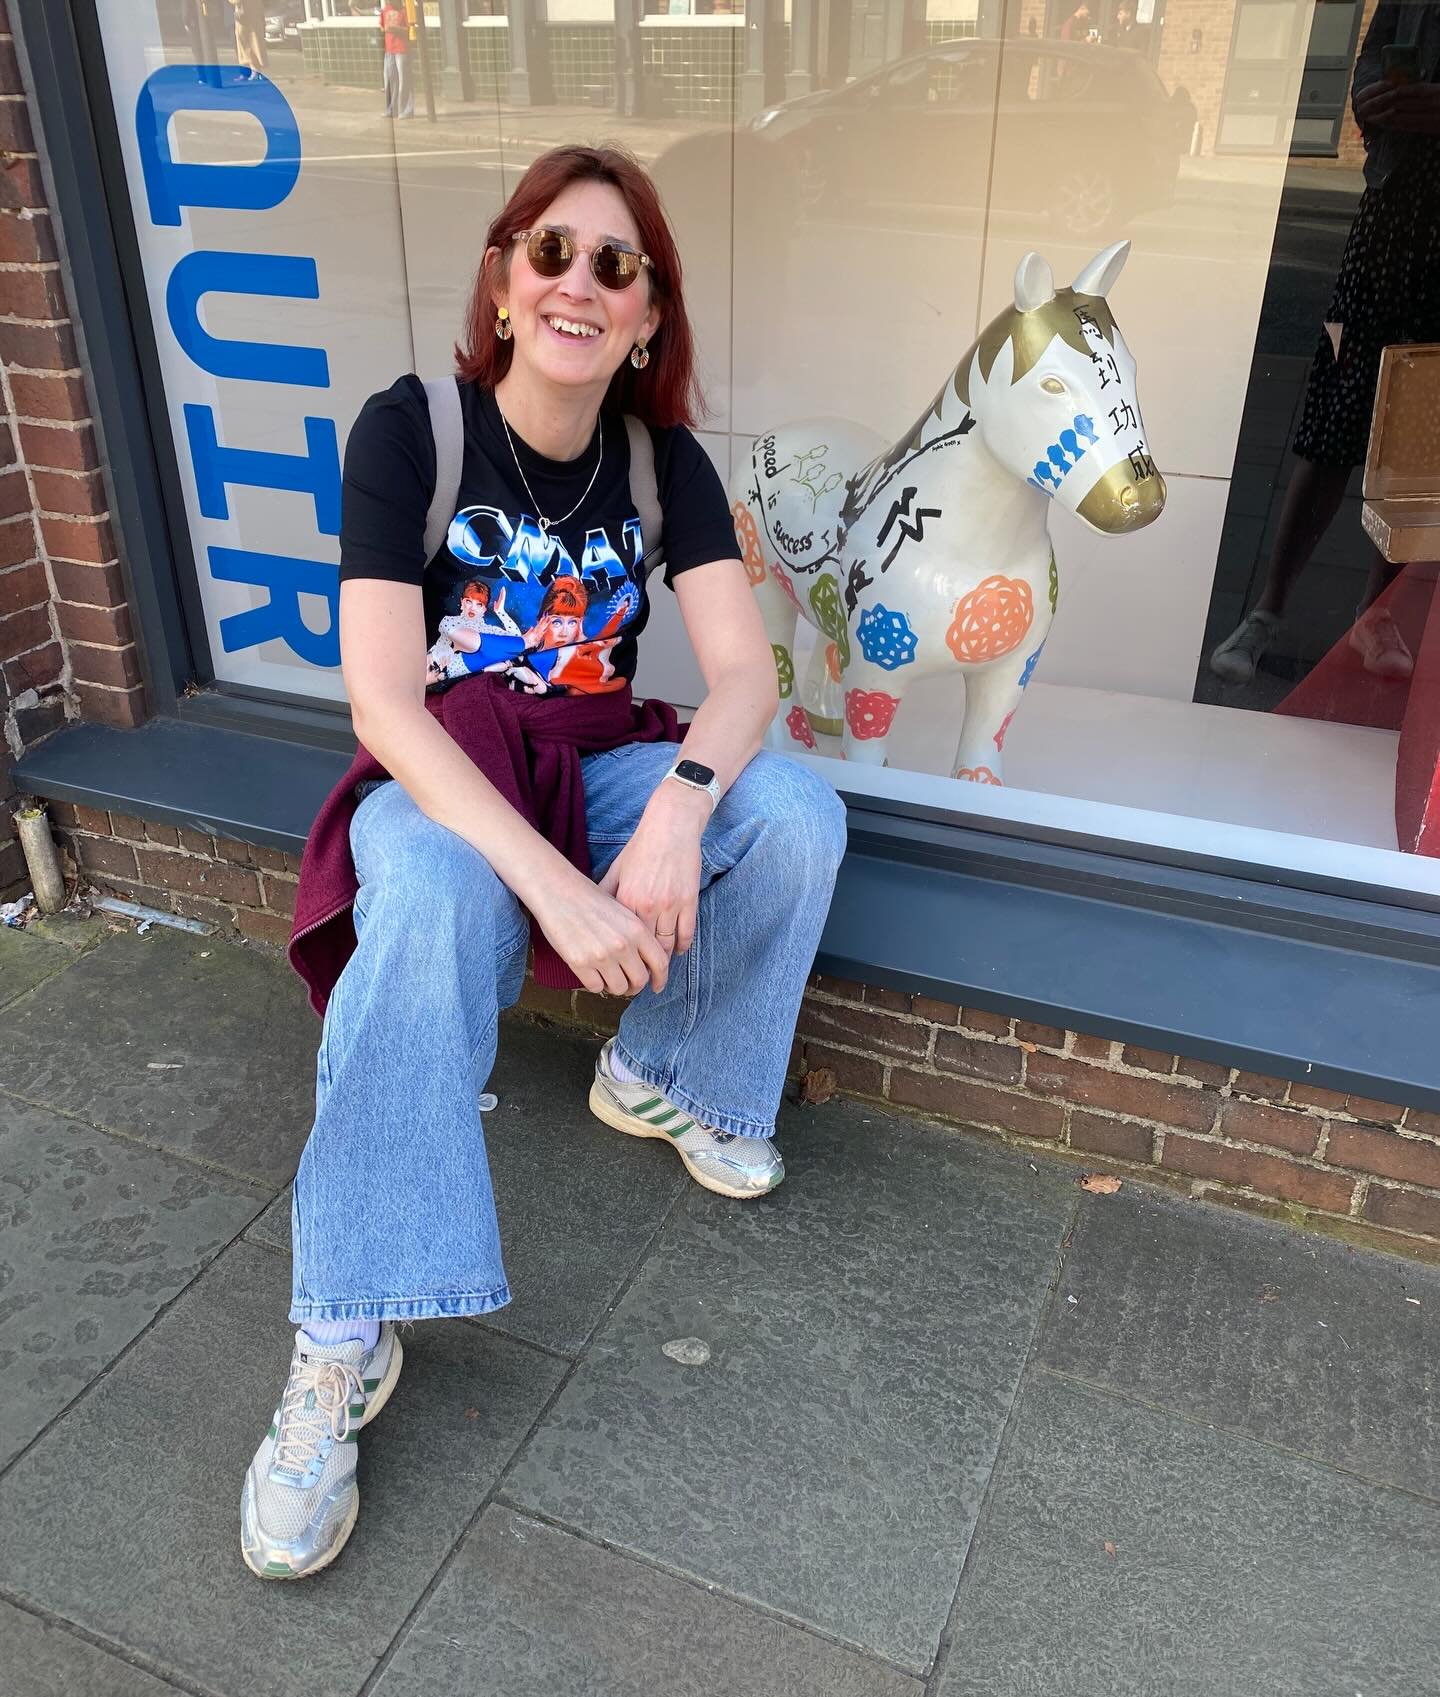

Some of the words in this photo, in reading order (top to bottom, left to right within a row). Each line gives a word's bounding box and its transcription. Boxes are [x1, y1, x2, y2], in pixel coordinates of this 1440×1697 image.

[135, 64, 343, 668] QUIR
[757, 434, 791, 479] speed
[767, 490, 781, 510] is
[773, 520, 814, 555] success
